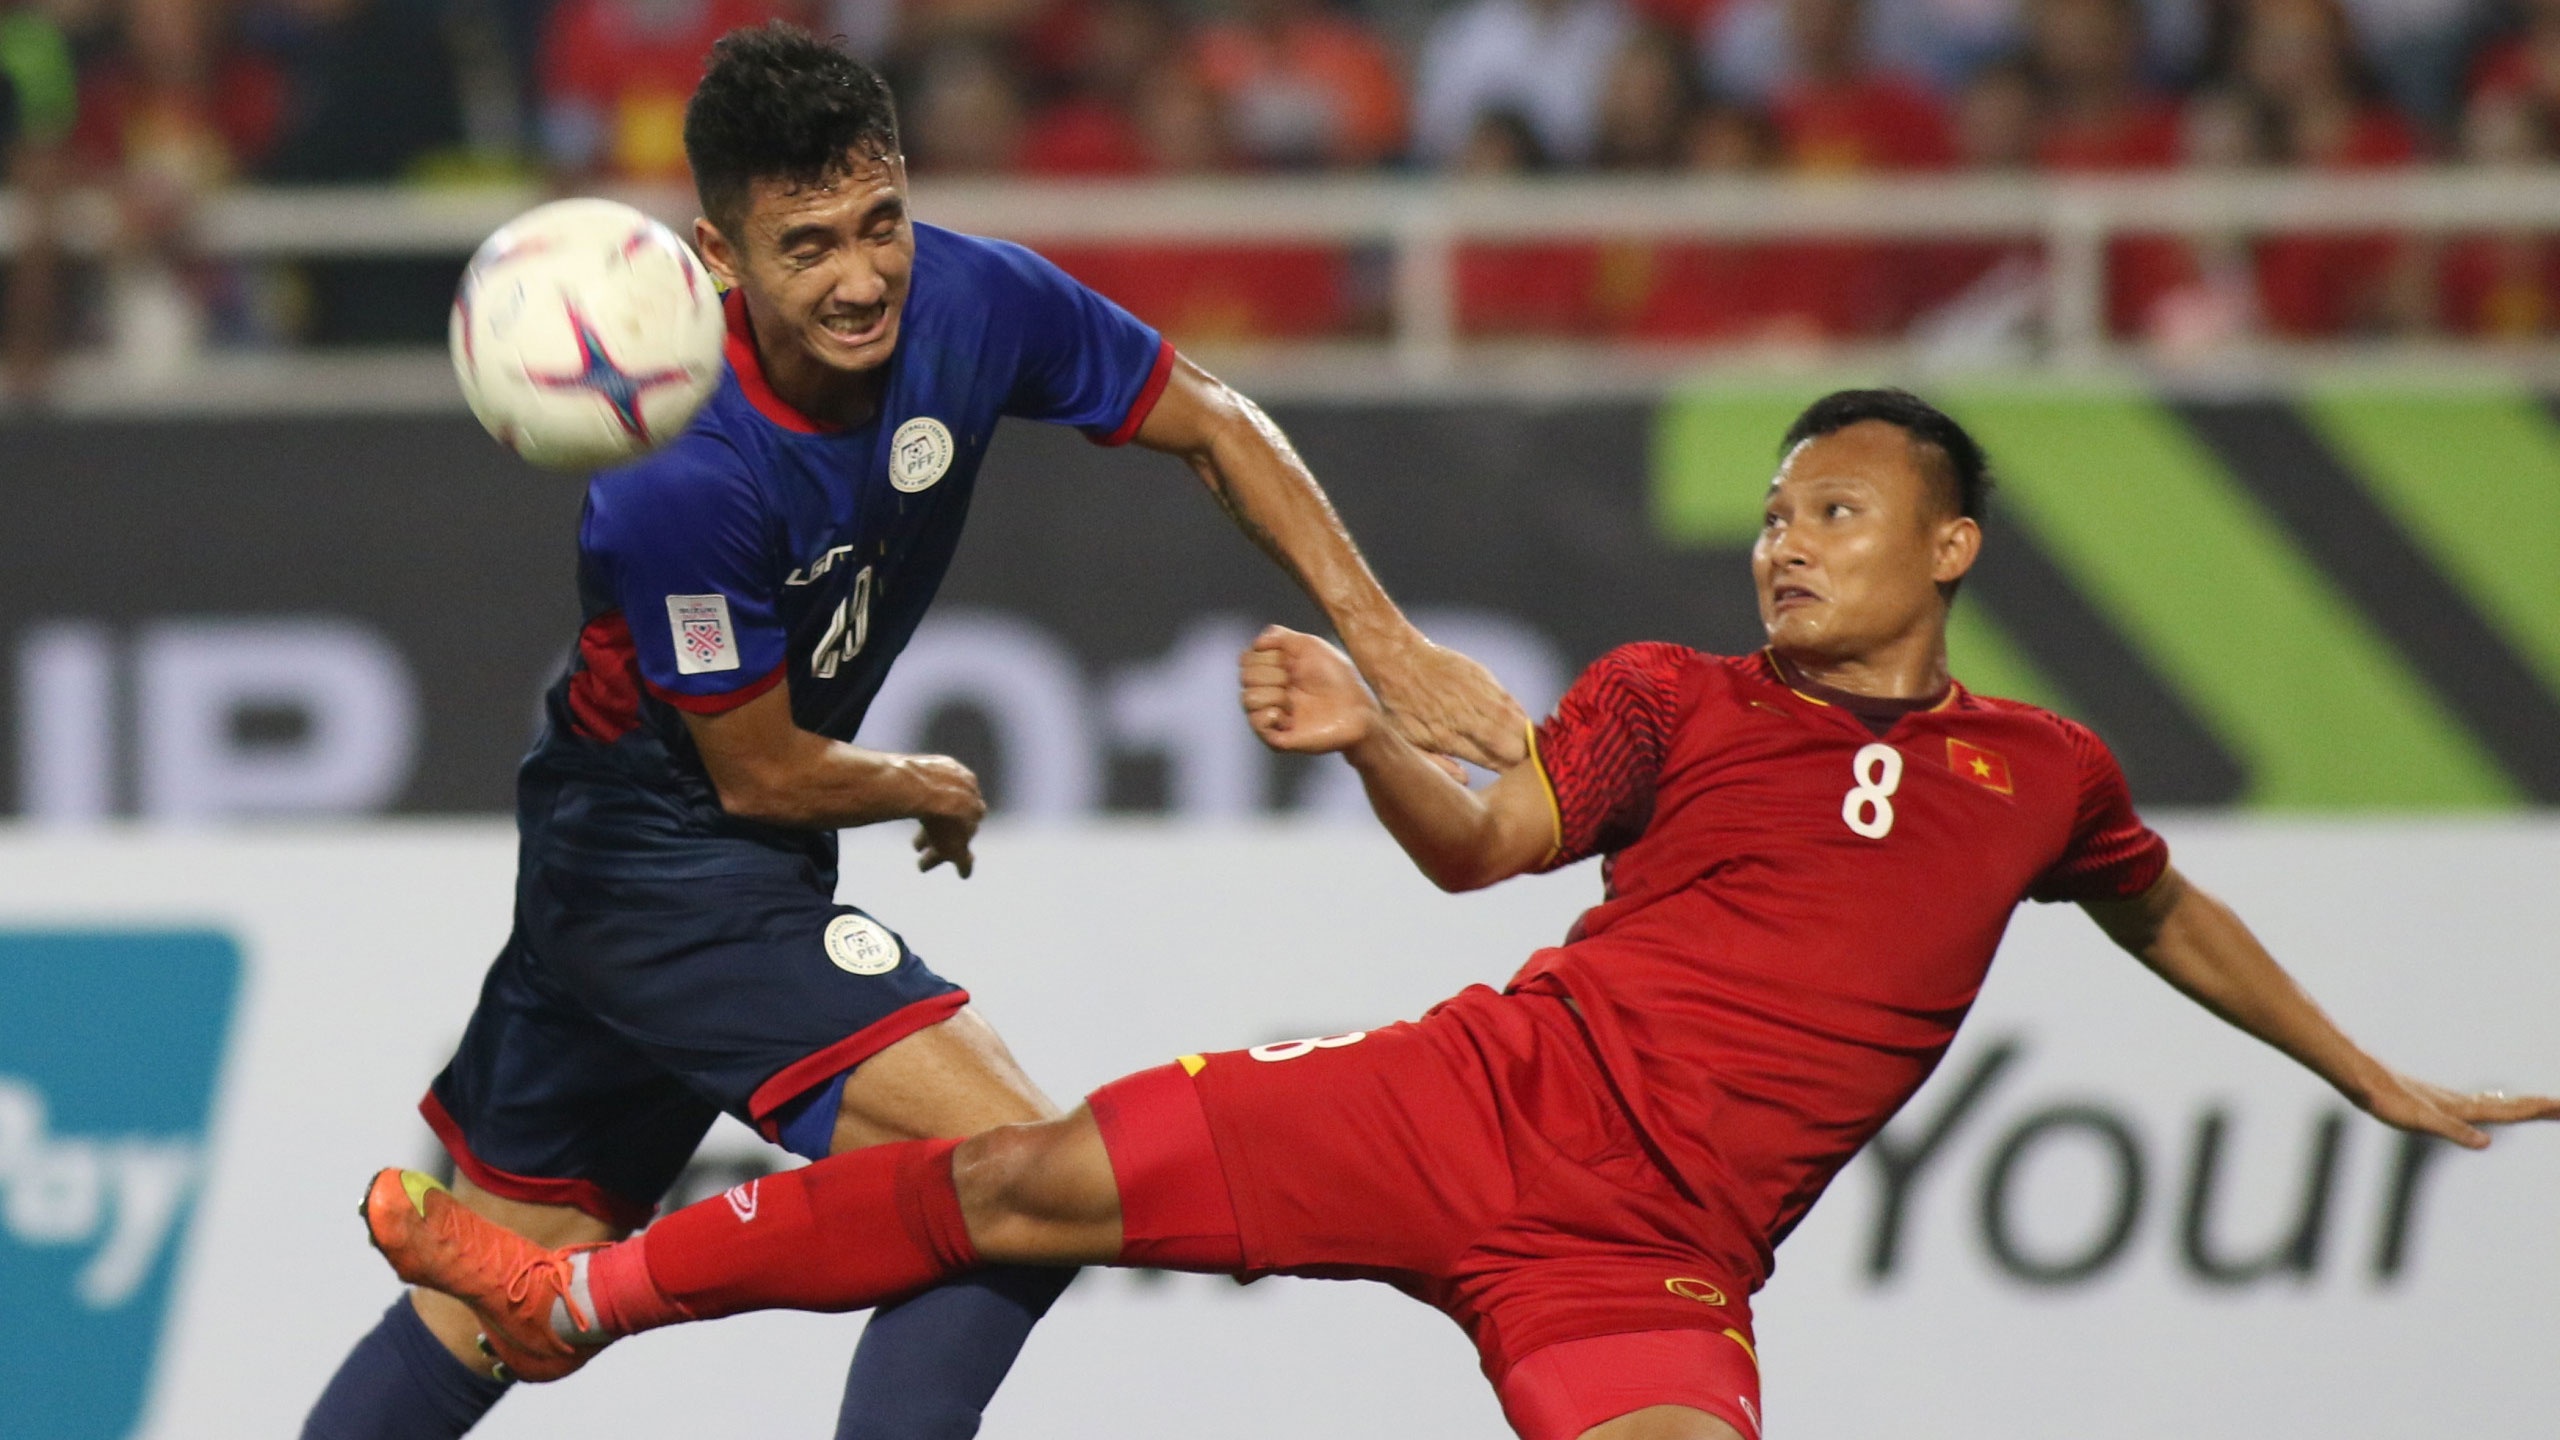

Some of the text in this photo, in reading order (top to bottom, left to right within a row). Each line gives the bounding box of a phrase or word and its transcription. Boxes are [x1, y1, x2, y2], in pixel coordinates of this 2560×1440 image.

[907, 451, 936, 475] PFF
[1841, 742, 1904, 840] 8
[1248, 1031, 1367, 1063] 8
[1855, 1012, 2505, 1298] Your
